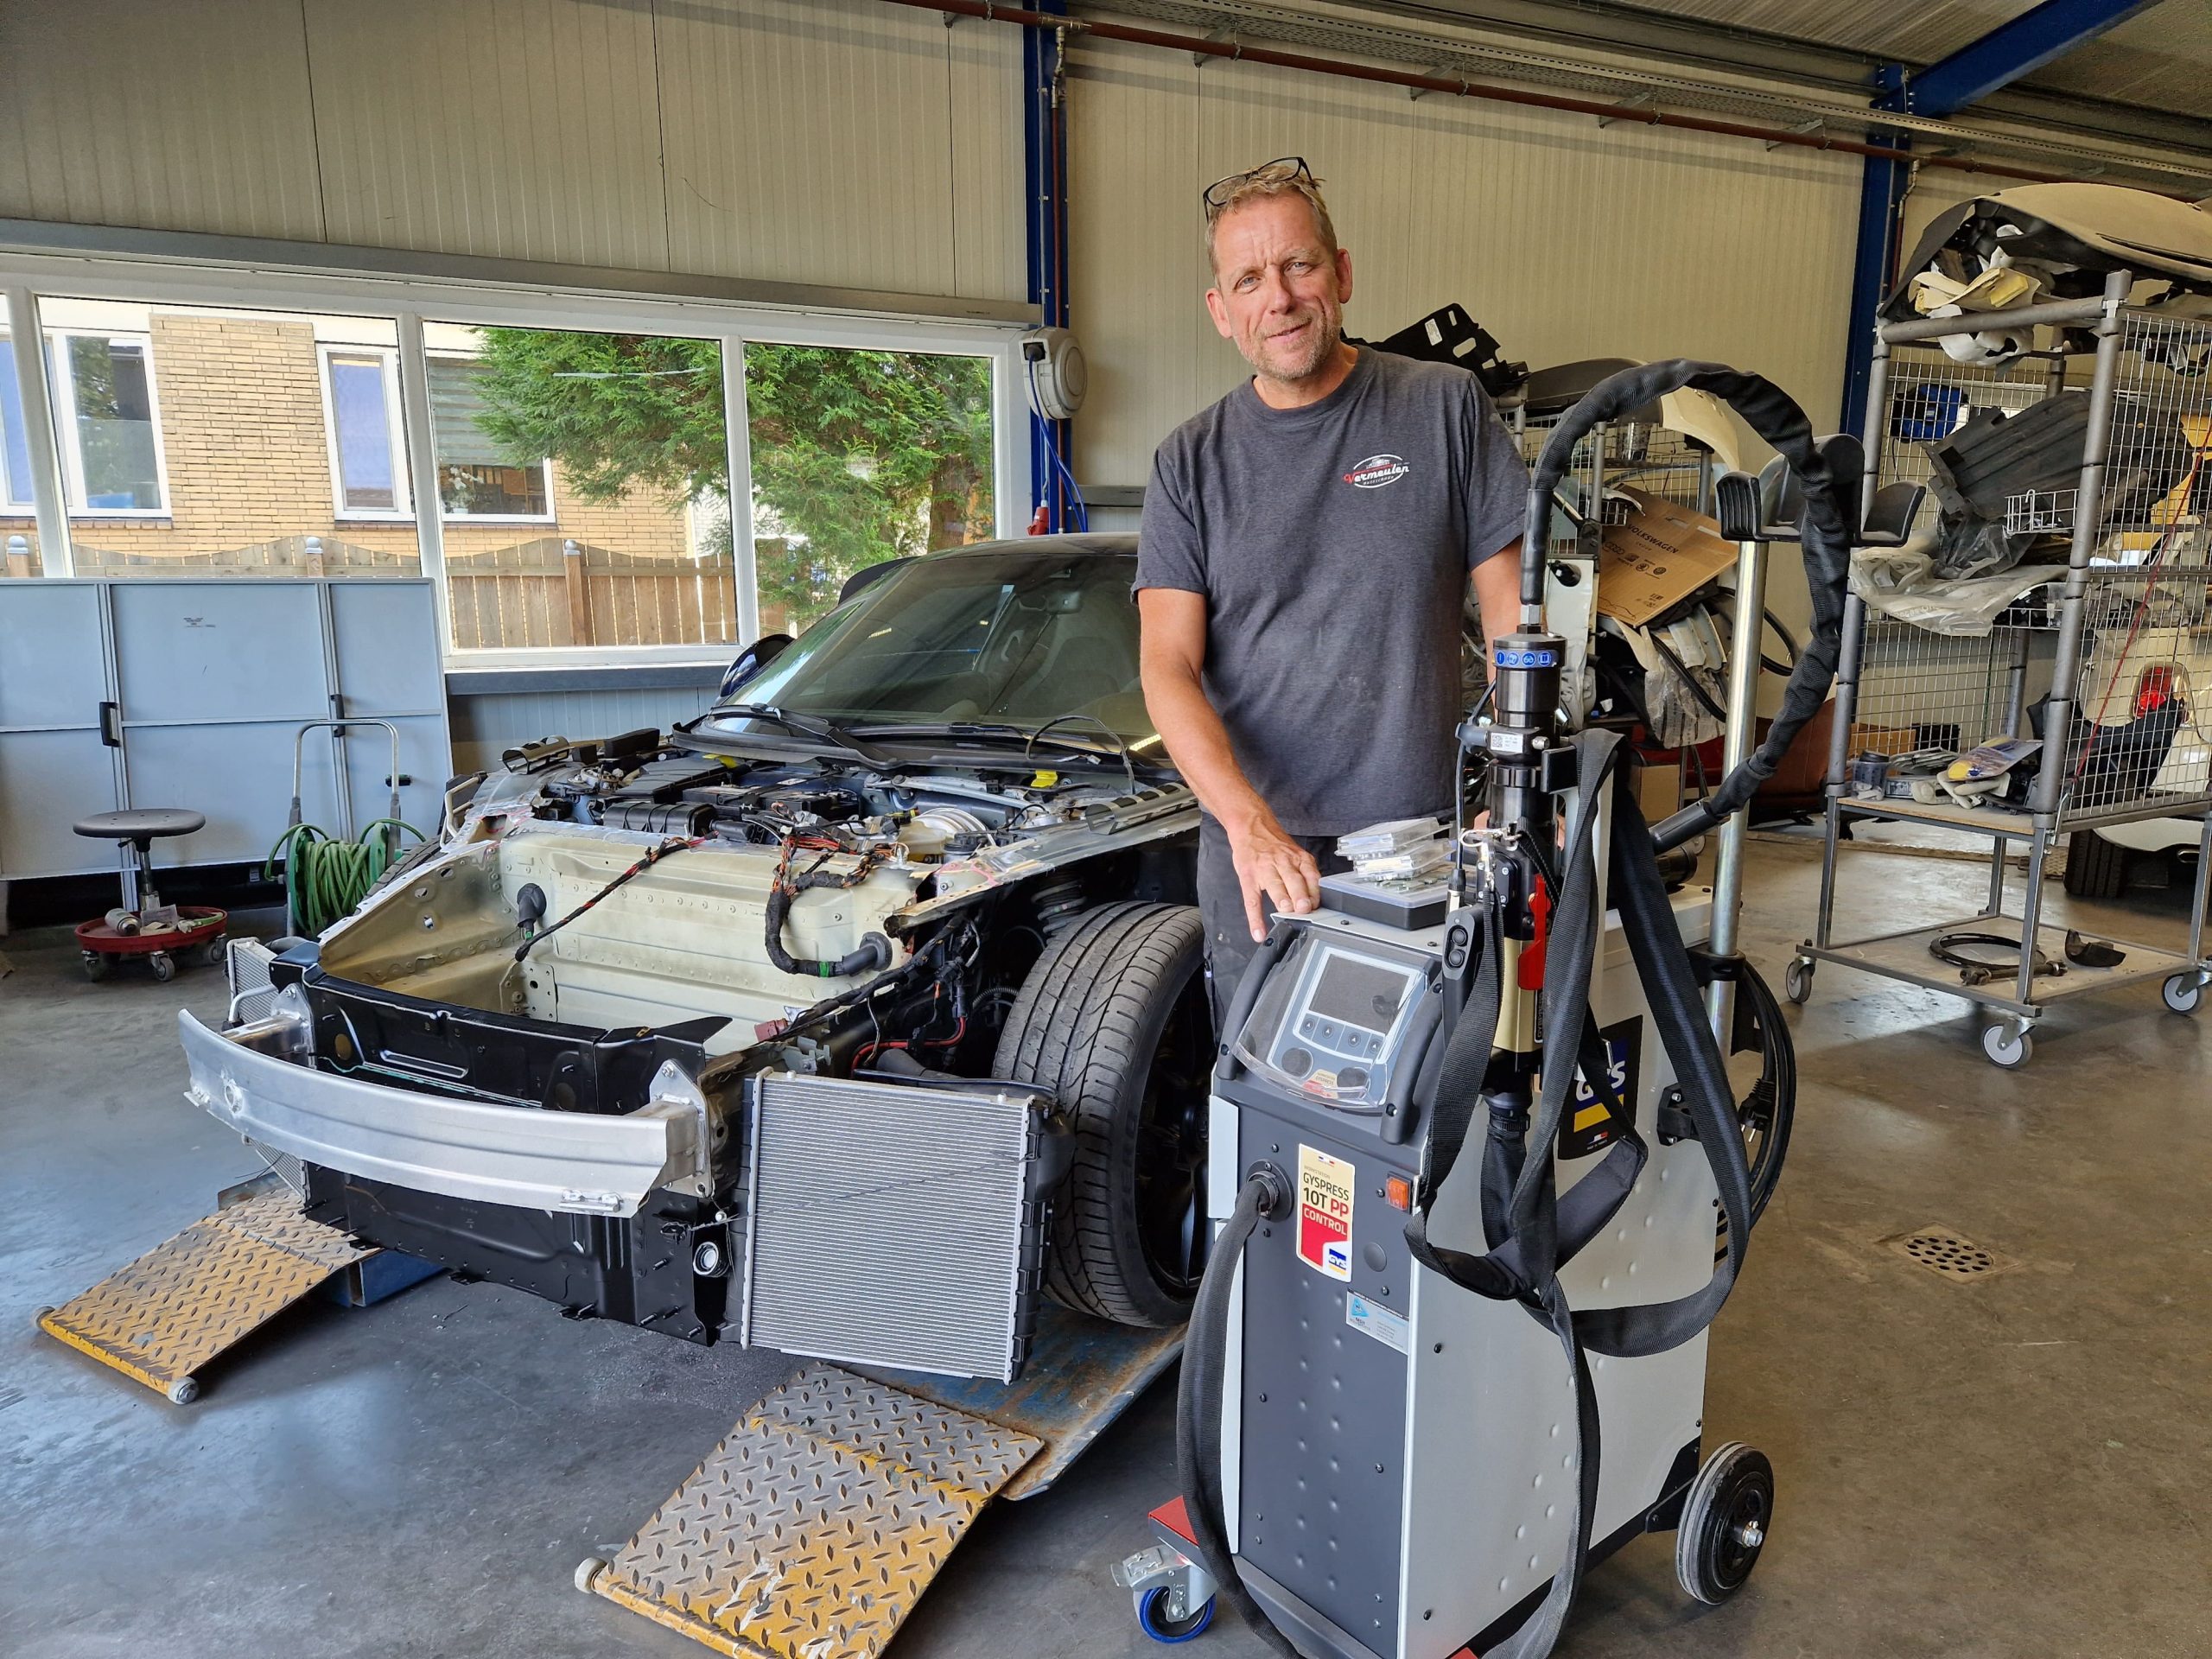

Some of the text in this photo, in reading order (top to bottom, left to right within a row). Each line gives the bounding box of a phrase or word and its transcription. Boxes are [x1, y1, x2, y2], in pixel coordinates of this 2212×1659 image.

[1344, 464, 1409, 484] Vermeulen
[1627, 523, 1679, 554] VOLKSWAGEN
[1575, 1060, 1626, 1102] GS
[1303, 1172, 1350, 1201] GYSPRESS
[1303, 1187, 1350, 1217] 10T PP
[1304, 1207, 1347, 1236] CONTROL
